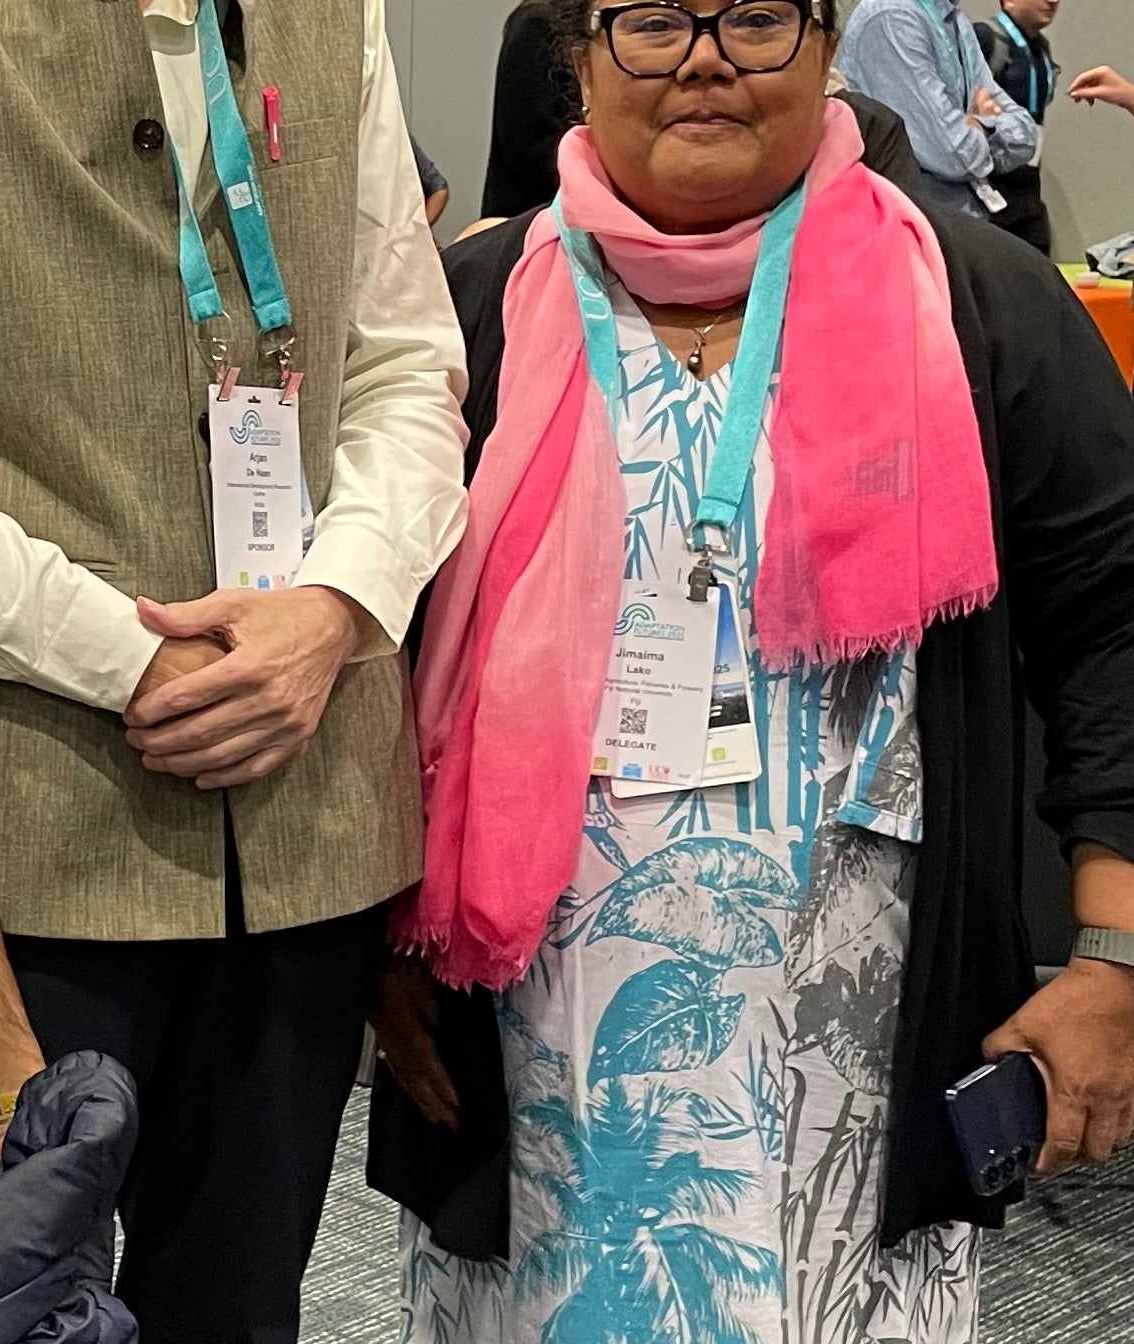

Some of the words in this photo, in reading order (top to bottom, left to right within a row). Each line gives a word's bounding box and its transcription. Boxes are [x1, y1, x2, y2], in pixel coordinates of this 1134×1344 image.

[626, 664, 652, 675] Lako
[714, 663, 731, 674] 25
[605, 738, 658, 752] DELEGATE
